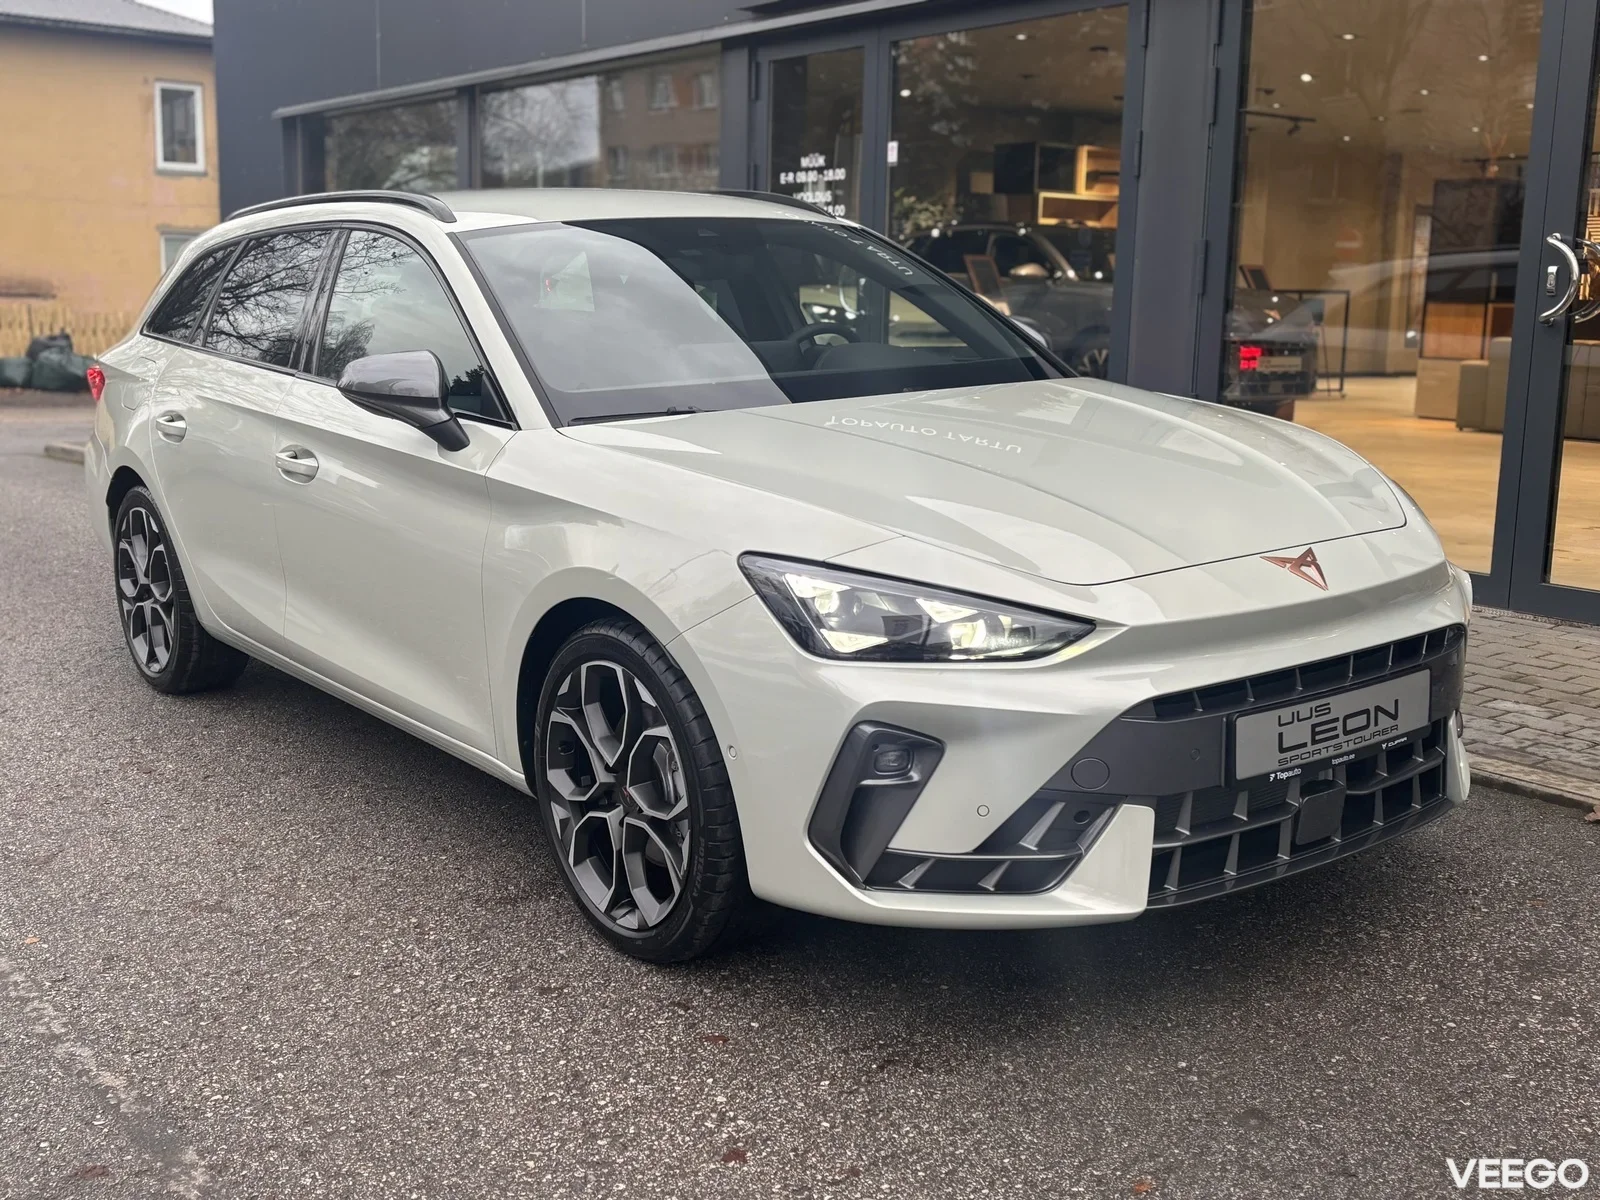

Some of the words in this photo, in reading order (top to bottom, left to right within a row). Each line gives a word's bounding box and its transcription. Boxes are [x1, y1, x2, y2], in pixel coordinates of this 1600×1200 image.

[1278, 702, 1332, 727] UUS
[1278, 699, 1399, 754] LEON
[1278, 724, 1399, 766] SPORTSTOURER
[1276, 768, 1302, 780] Topauto
